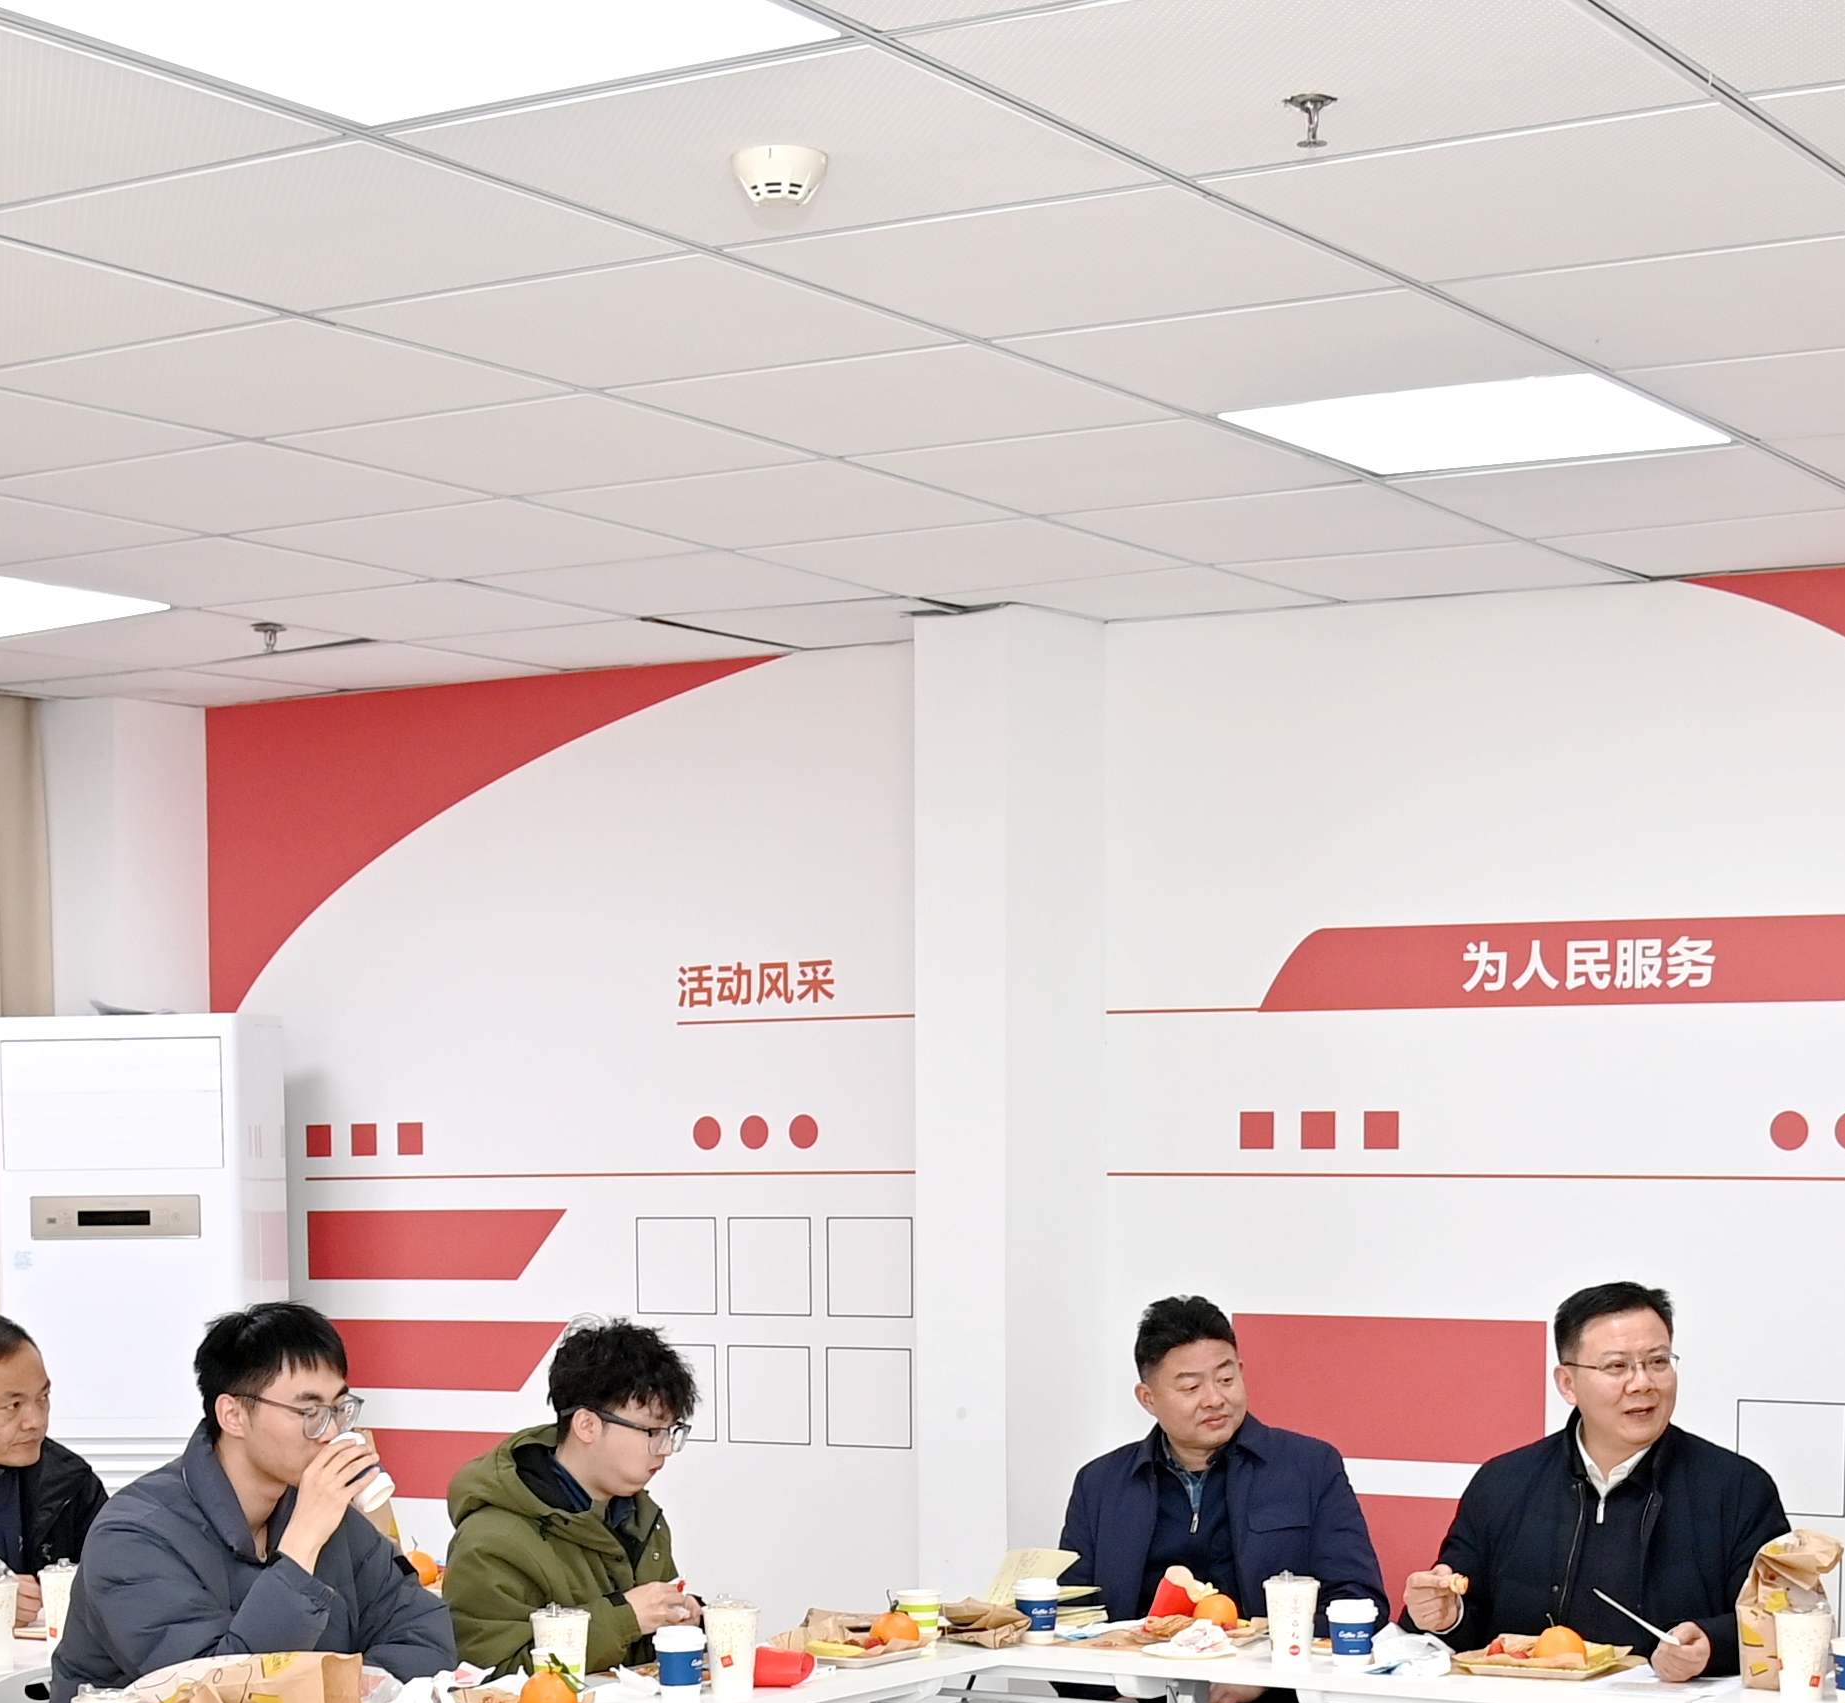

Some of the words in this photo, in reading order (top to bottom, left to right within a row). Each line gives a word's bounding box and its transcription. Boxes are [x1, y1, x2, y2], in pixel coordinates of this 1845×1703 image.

[677, 959, 835, 1008] 活动风采
[1461, 935, 1716, 992] 为人民服务
